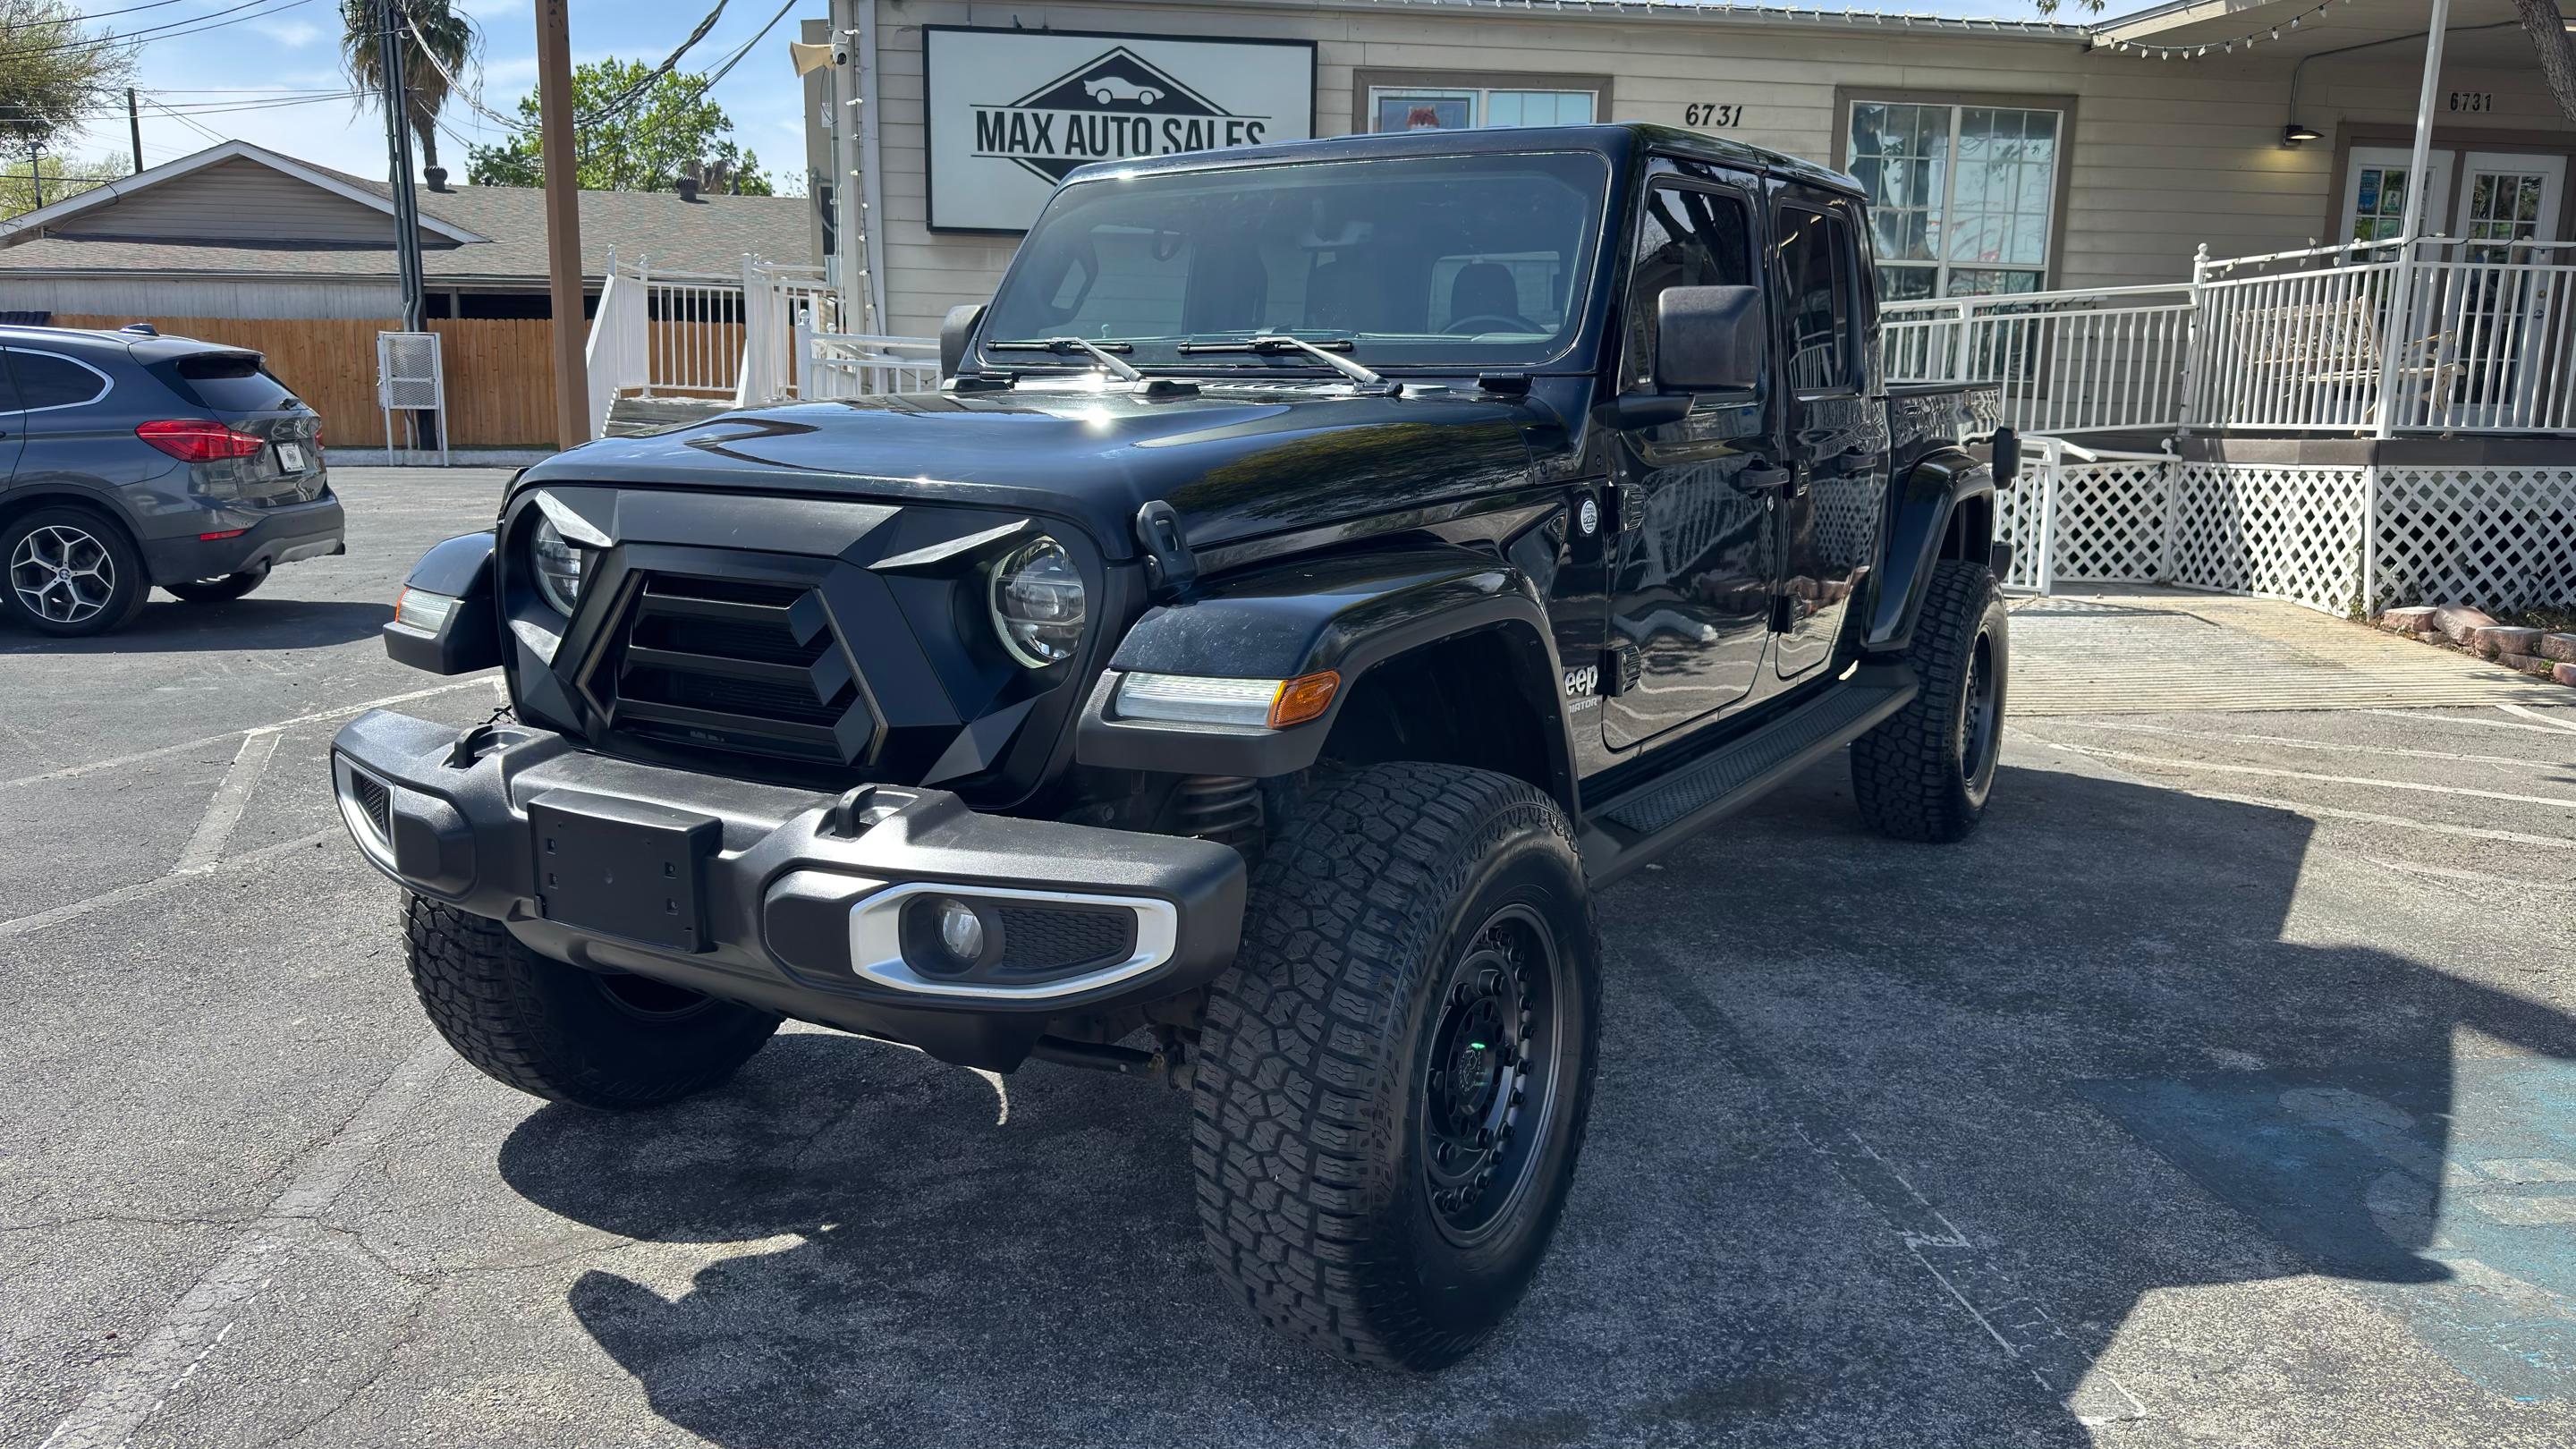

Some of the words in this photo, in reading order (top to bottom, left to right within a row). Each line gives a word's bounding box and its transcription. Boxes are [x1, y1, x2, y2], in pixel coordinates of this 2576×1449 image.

[1685, 103, 1743, 127] 6731
[2450, 92, 2491, 112] 6731
[976, 110, 1055, 155] MAX
[1064, 114, 1152, 157] AUTO
[1162, 117, 1266, 156] SALES
[1563, 665, 1598, 696] eep
